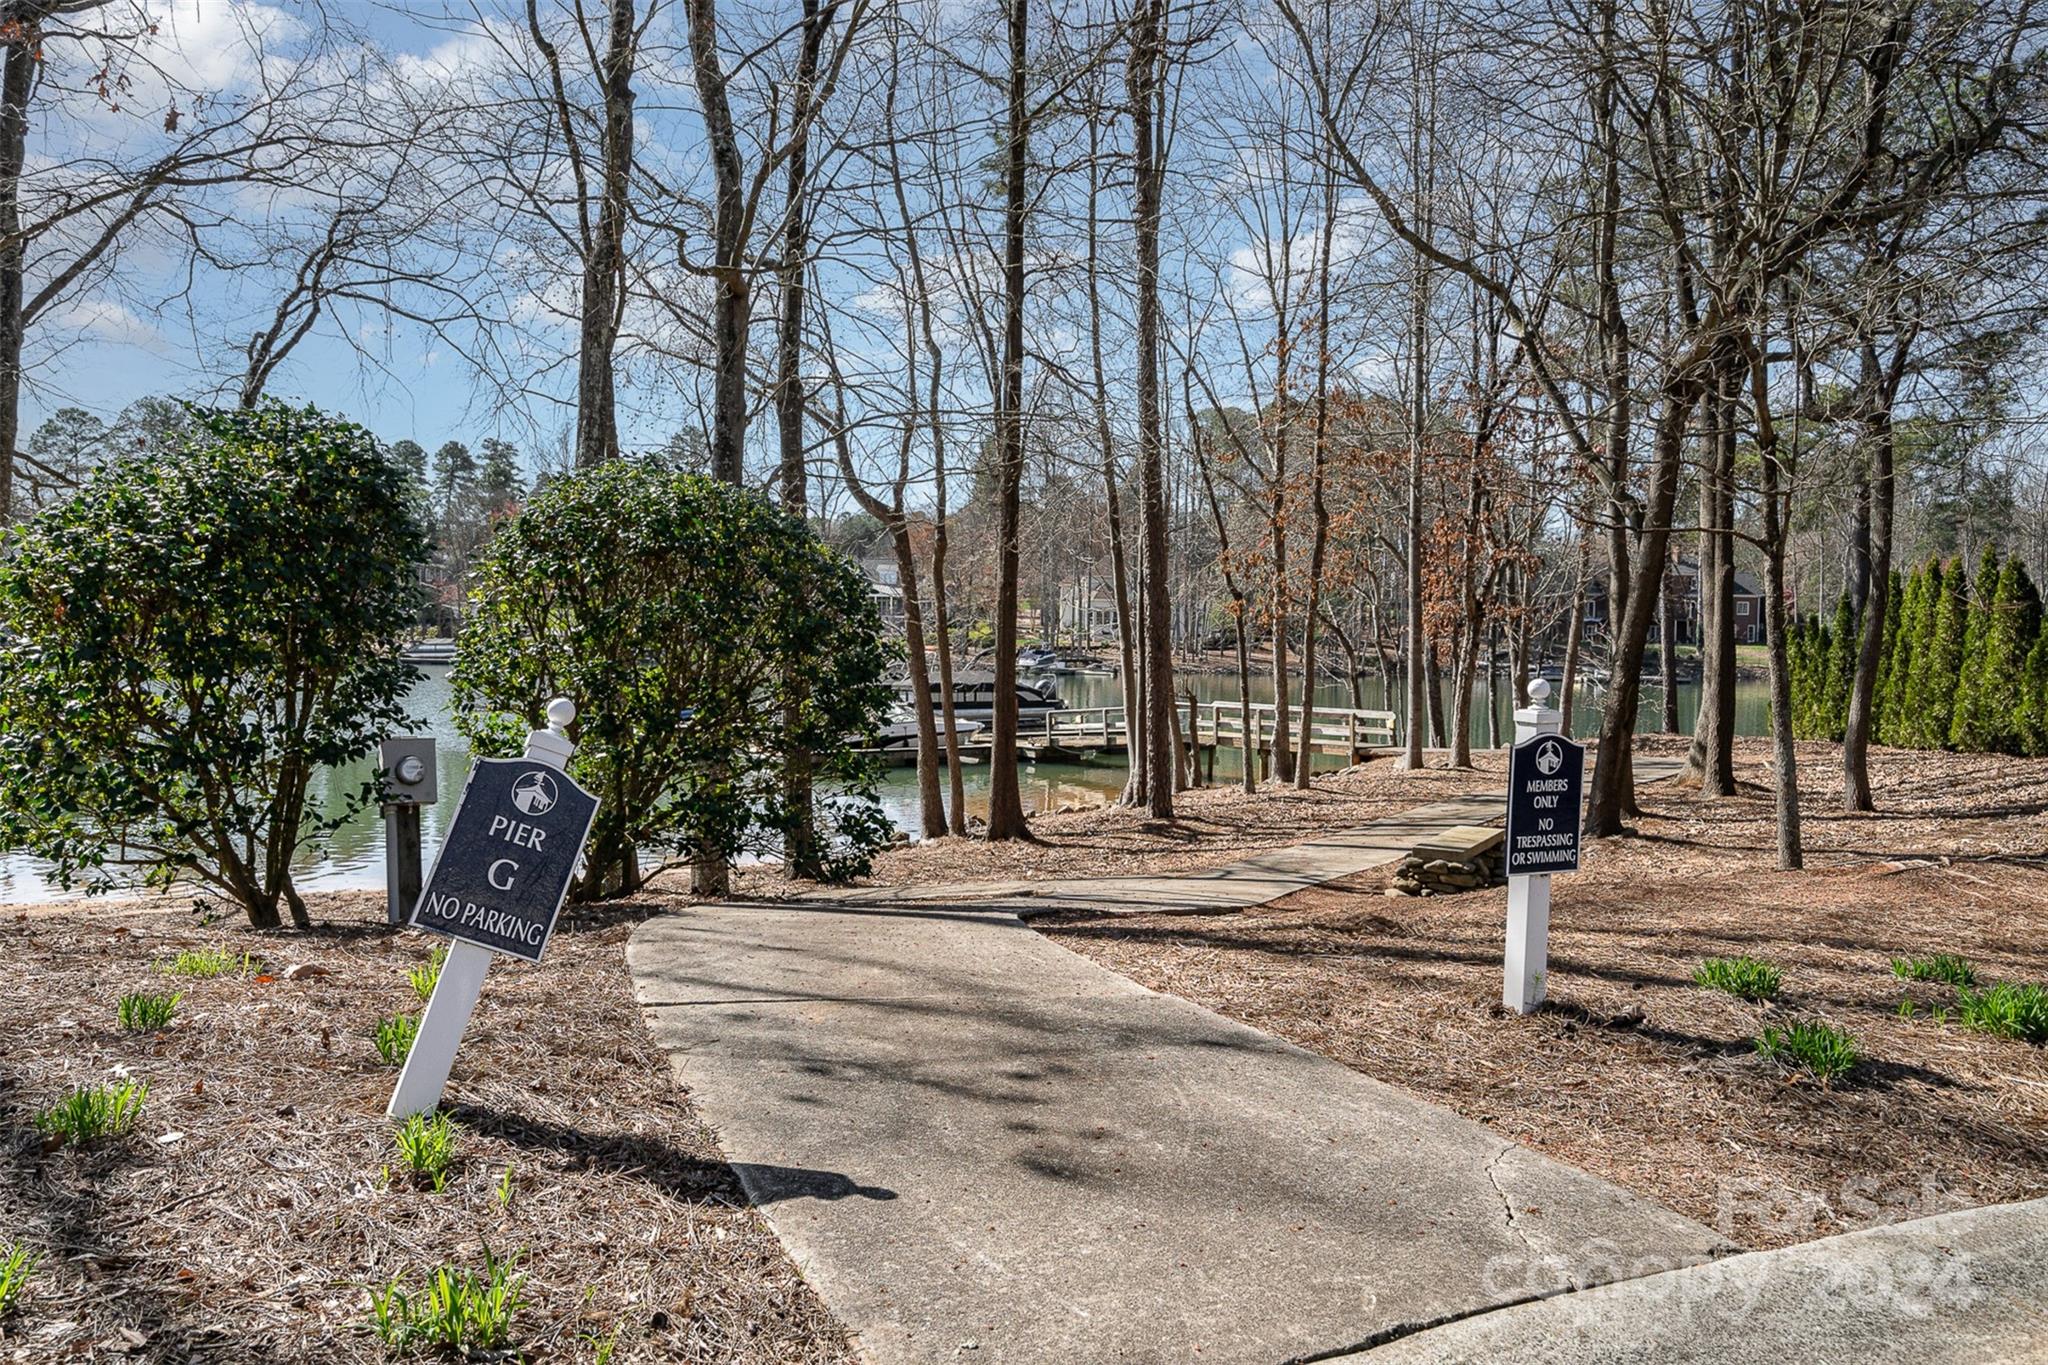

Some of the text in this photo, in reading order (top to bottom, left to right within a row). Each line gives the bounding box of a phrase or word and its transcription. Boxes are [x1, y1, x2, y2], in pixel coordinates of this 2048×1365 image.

[1527, 780, 1568, 792] MEMBERS
[1534, 796, 1559, 808] ONLY
[1539, 818, 1554, 831] NO
[488, 814, 547, 852] PIER
[1517, 833, 1573, 848] TRESPASSING
[1512, 850, 1576, 865] OR SWIMMING
[487, 858, 520, 891] G
[424, 891, 544, 946] NO PARKING
